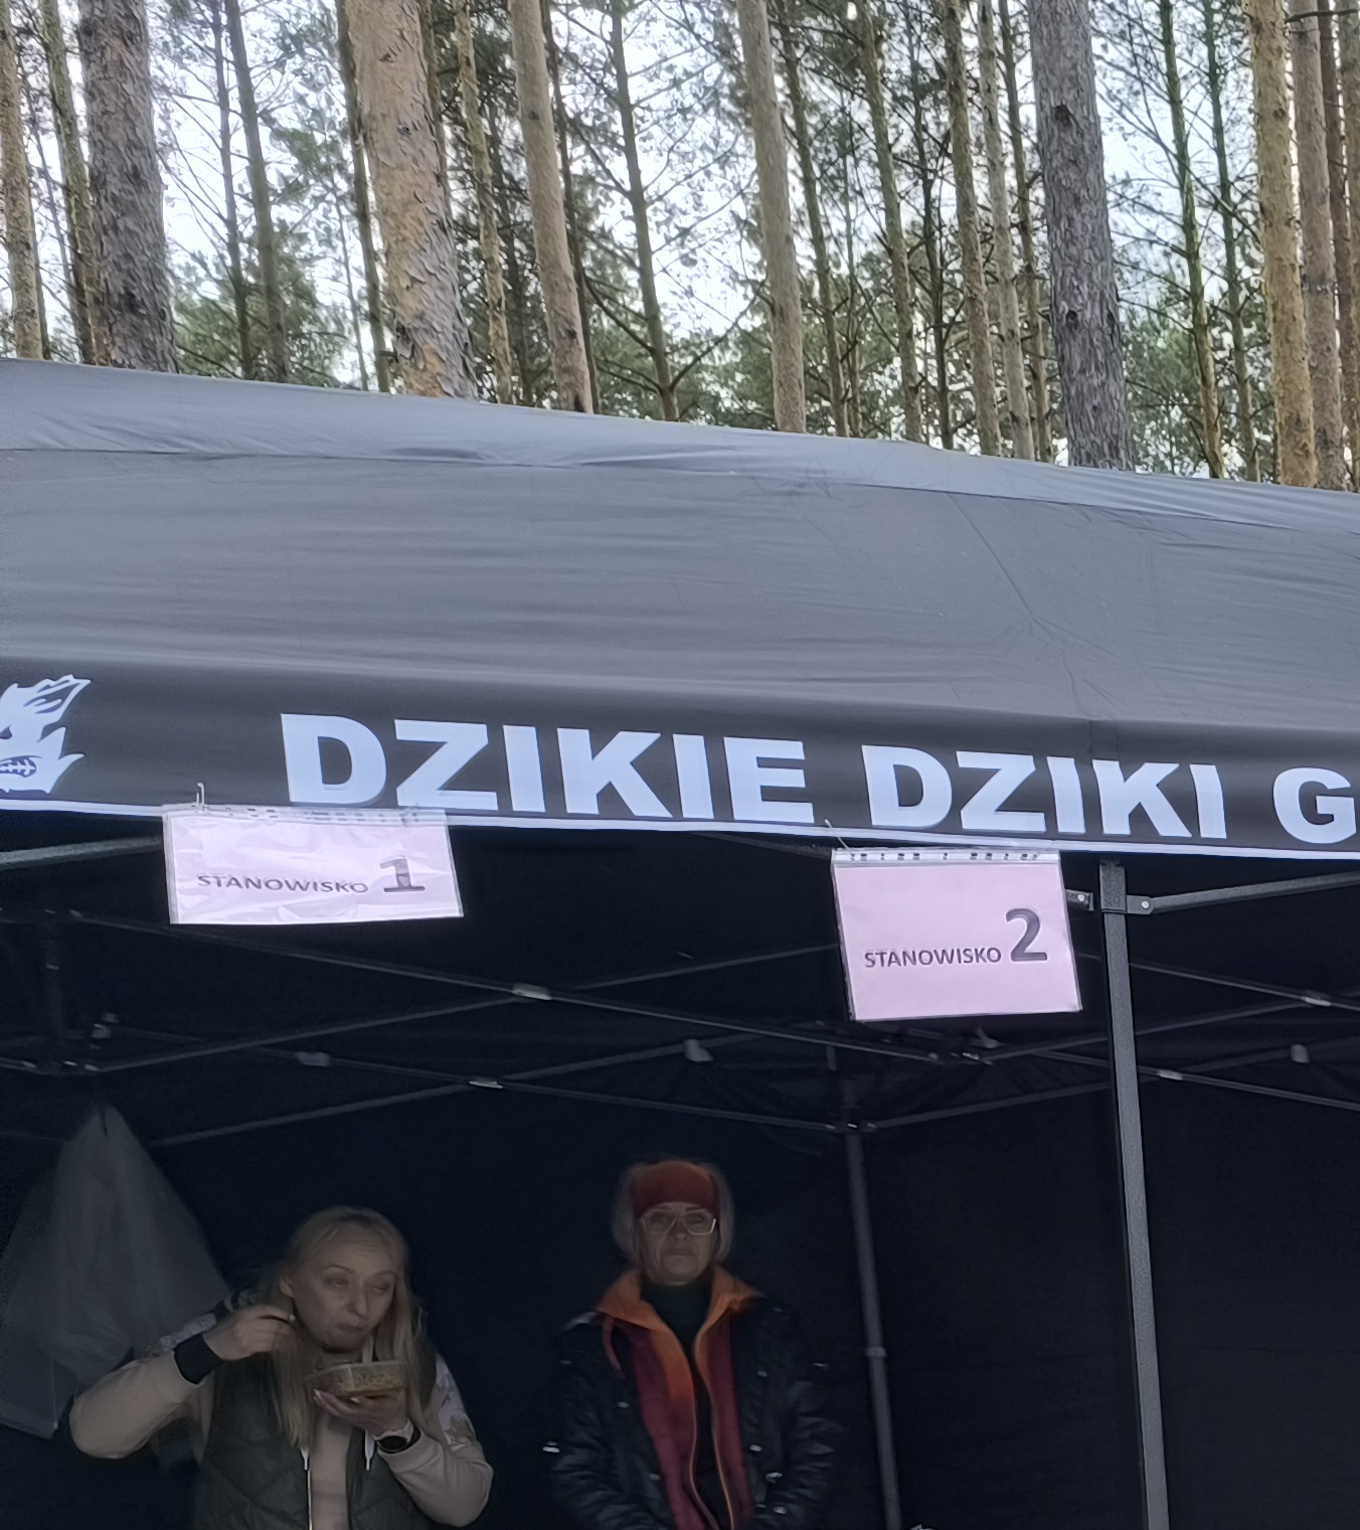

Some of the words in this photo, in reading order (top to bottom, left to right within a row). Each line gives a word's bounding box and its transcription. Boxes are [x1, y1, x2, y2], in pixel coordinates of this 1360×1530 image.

[280, 712, 816, 825] DZIKIE
[861, 745, 1227, 839] DZIKI
[195, 872, 369, 895] STANOWISKO
[381, 855, 427, 894] 1
[864, 946, 1002, 968] STANOWISKO
[1005, 907, 1048, 963] 2
